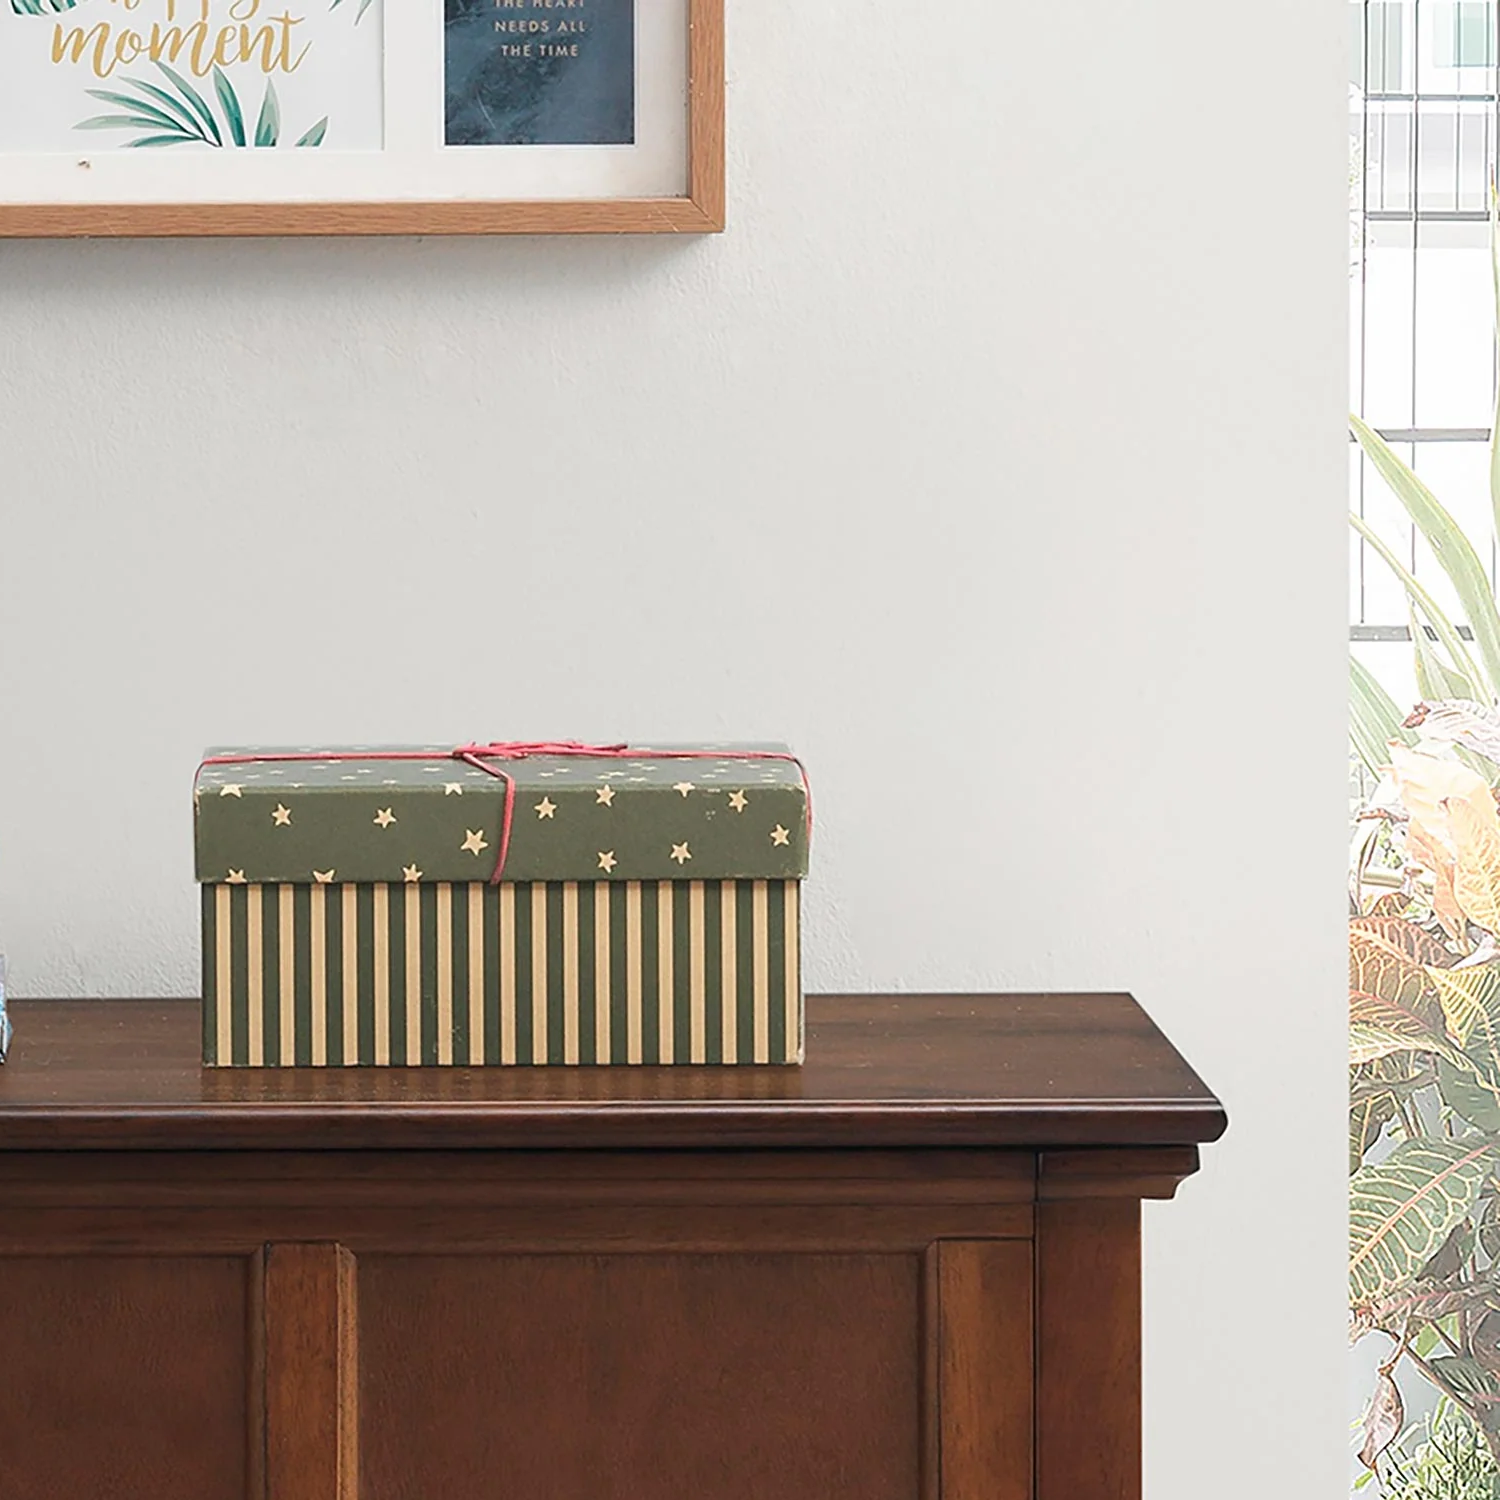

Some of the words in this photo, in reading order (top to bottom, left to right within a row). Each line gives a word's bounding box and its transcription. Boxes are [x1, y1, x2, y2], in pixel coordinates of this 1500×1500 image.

[494, 20, 550, 33] NEEDS
[557, 20, 586, 32] ALL
[51, 10, 313, 78] moment
[501, 44, 532, 57] THE
[539, 44, 579, 57] TIME
